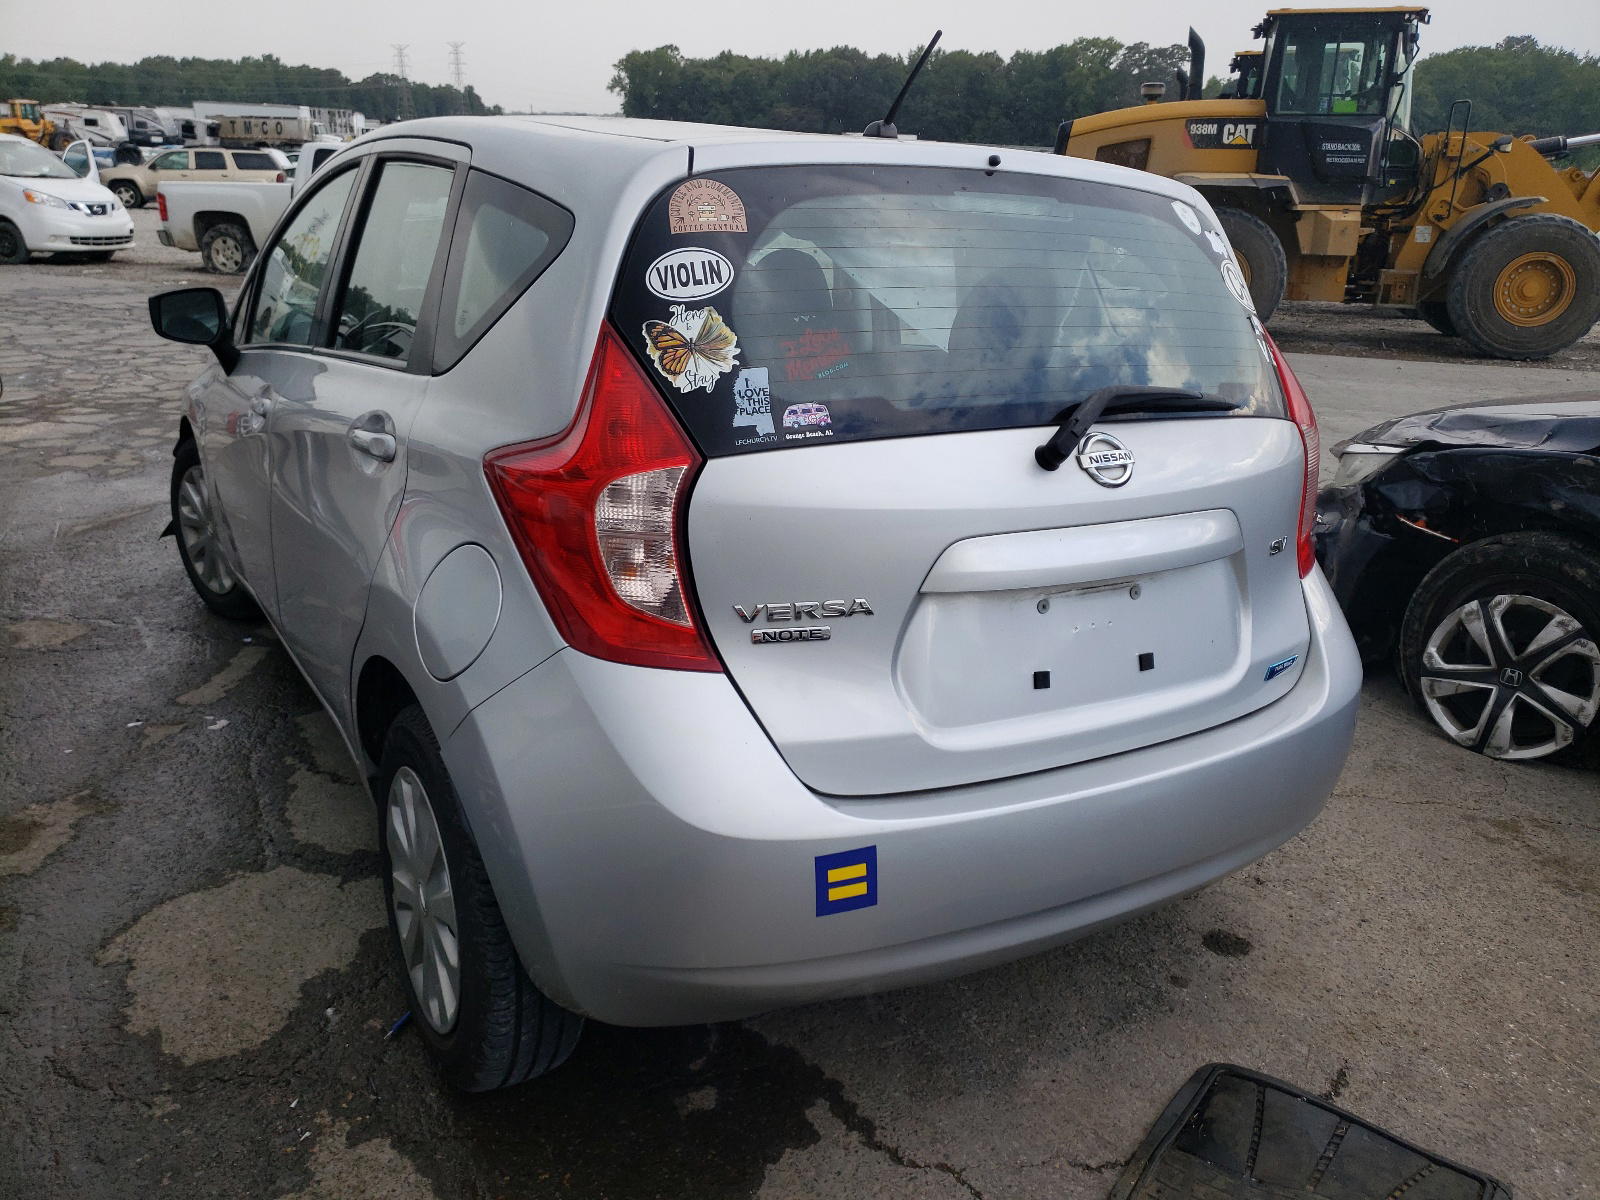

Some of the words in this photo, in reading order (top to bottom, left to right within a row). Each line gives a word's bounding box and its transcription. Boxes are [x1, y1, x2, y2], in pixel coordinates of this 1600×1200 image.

[1190, 124, 1217, 135] 938M
[1222, 124, 1256, 144] CAT
[669, 189, 687, 217] COFFEE
[684, 180, 703, 193] AND
[705, 180, 745, 218] COMMUNITY
[707, 222, 745, 232] CENTRAL
[656, 260, 723, 290] VIOLIN
[670, 305, 706, 327] Here
[683, 369, 716, 393] Stay
[744, 378, 750, 388] I
[738, 387, 769, 399] LOVE
[746, 397, 770, 407] THIS
[739, 406, 771, 416] PLACE
[1089, 452, 1132, 465] NISSAN
[732, 598, 875, 624] VERSA
[762, 629, 823, 643] NOTE
